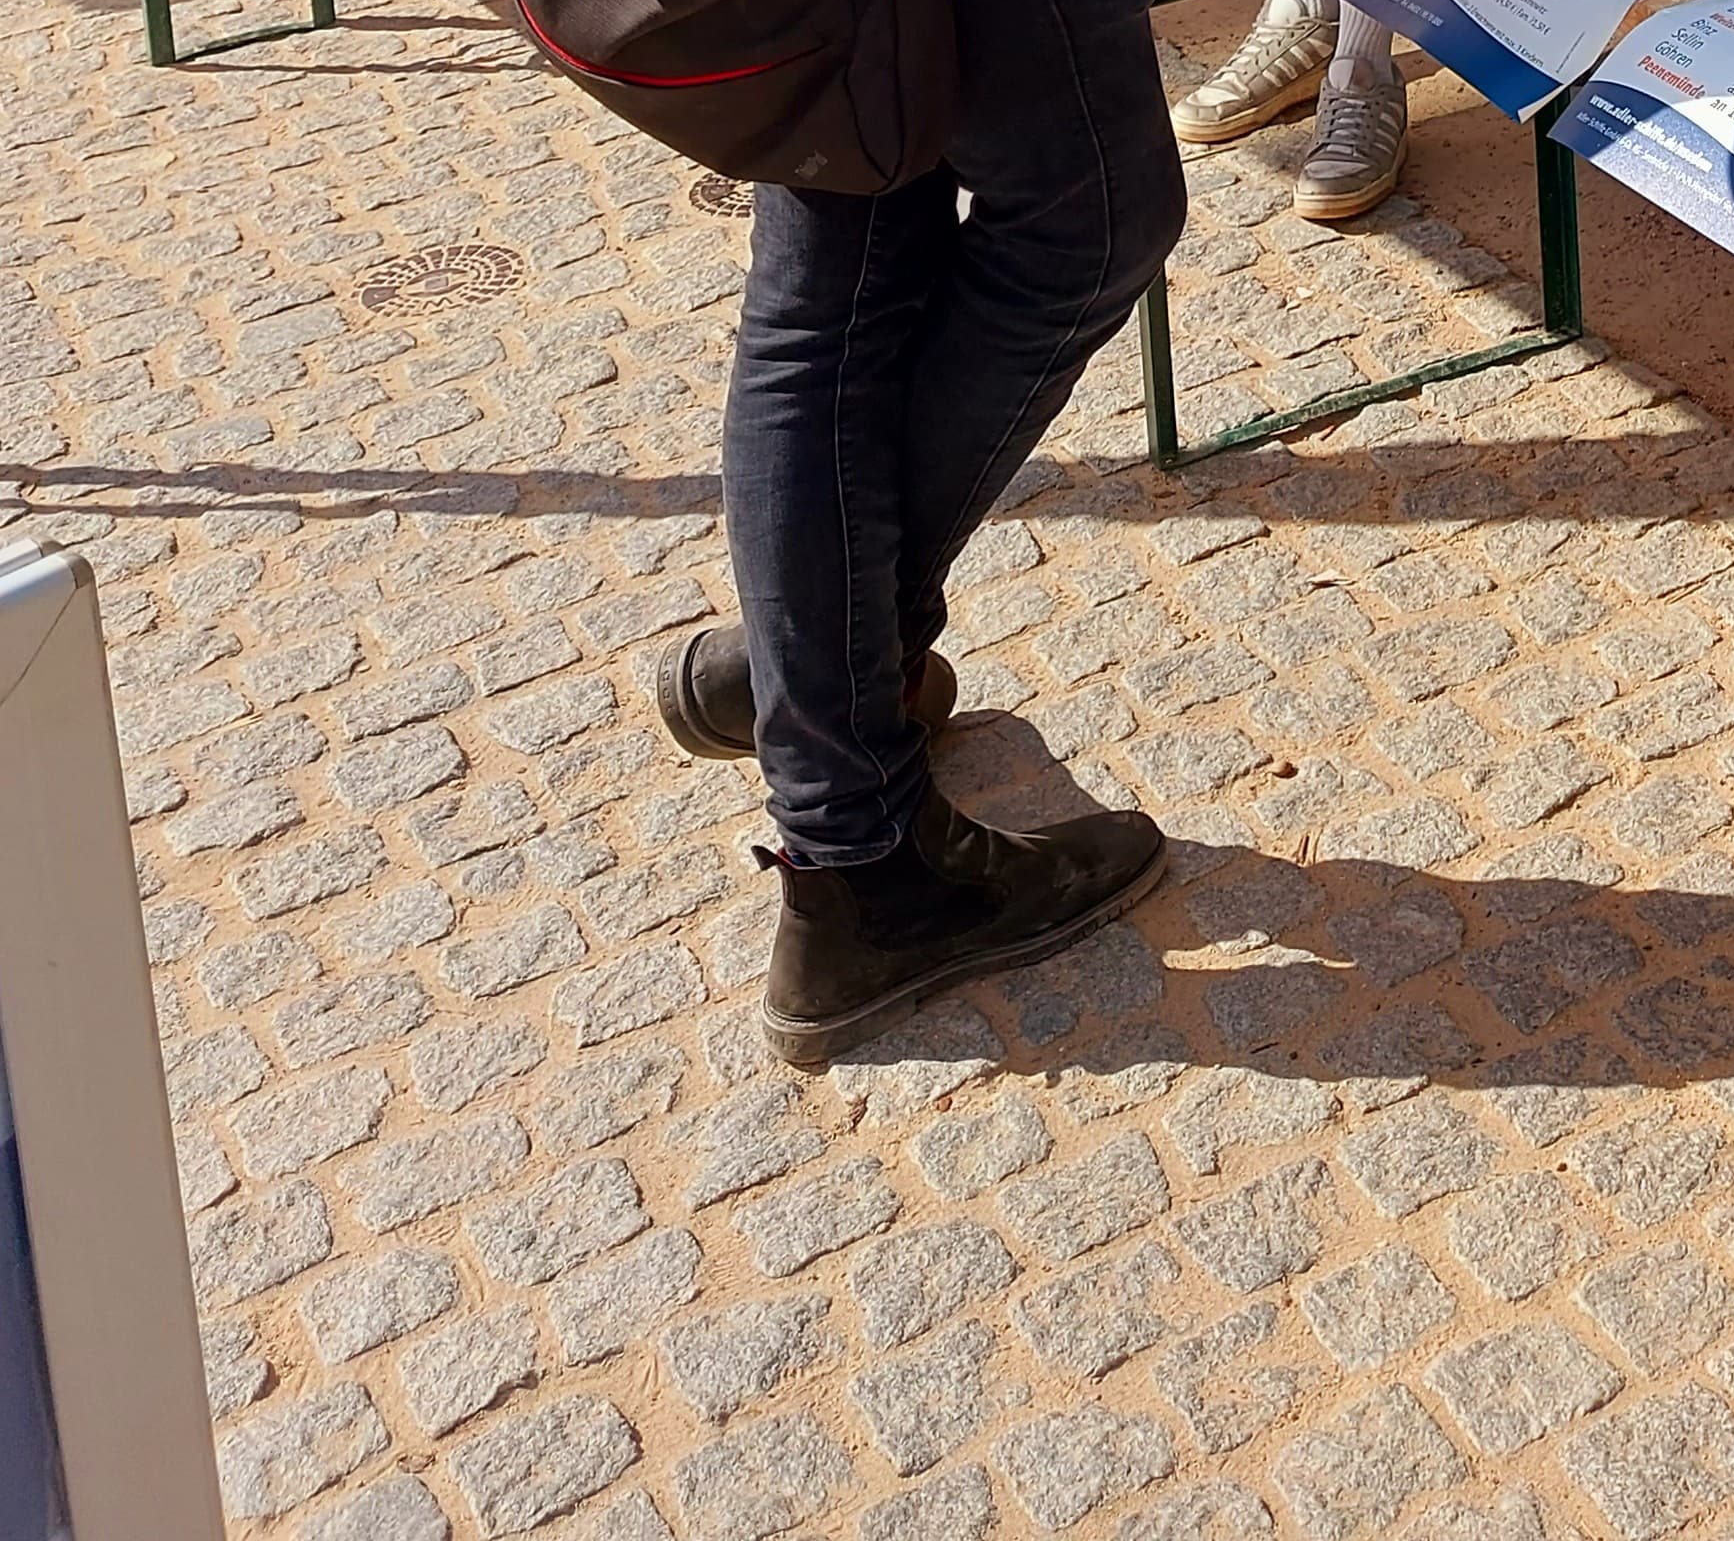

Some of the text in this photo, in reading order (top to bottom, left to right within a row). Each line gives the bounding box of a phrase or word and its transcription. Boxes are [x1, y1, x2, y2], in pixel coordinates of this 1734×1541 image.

[1670, 27, 1706, 51] Sellin
[1689, 18, 1719, 38] Binz
[1654, 40, 1694, 70] Göhren
[1637, 54, 1707, 101] Peenemünde
[1709, 97, 1728, 113] an
